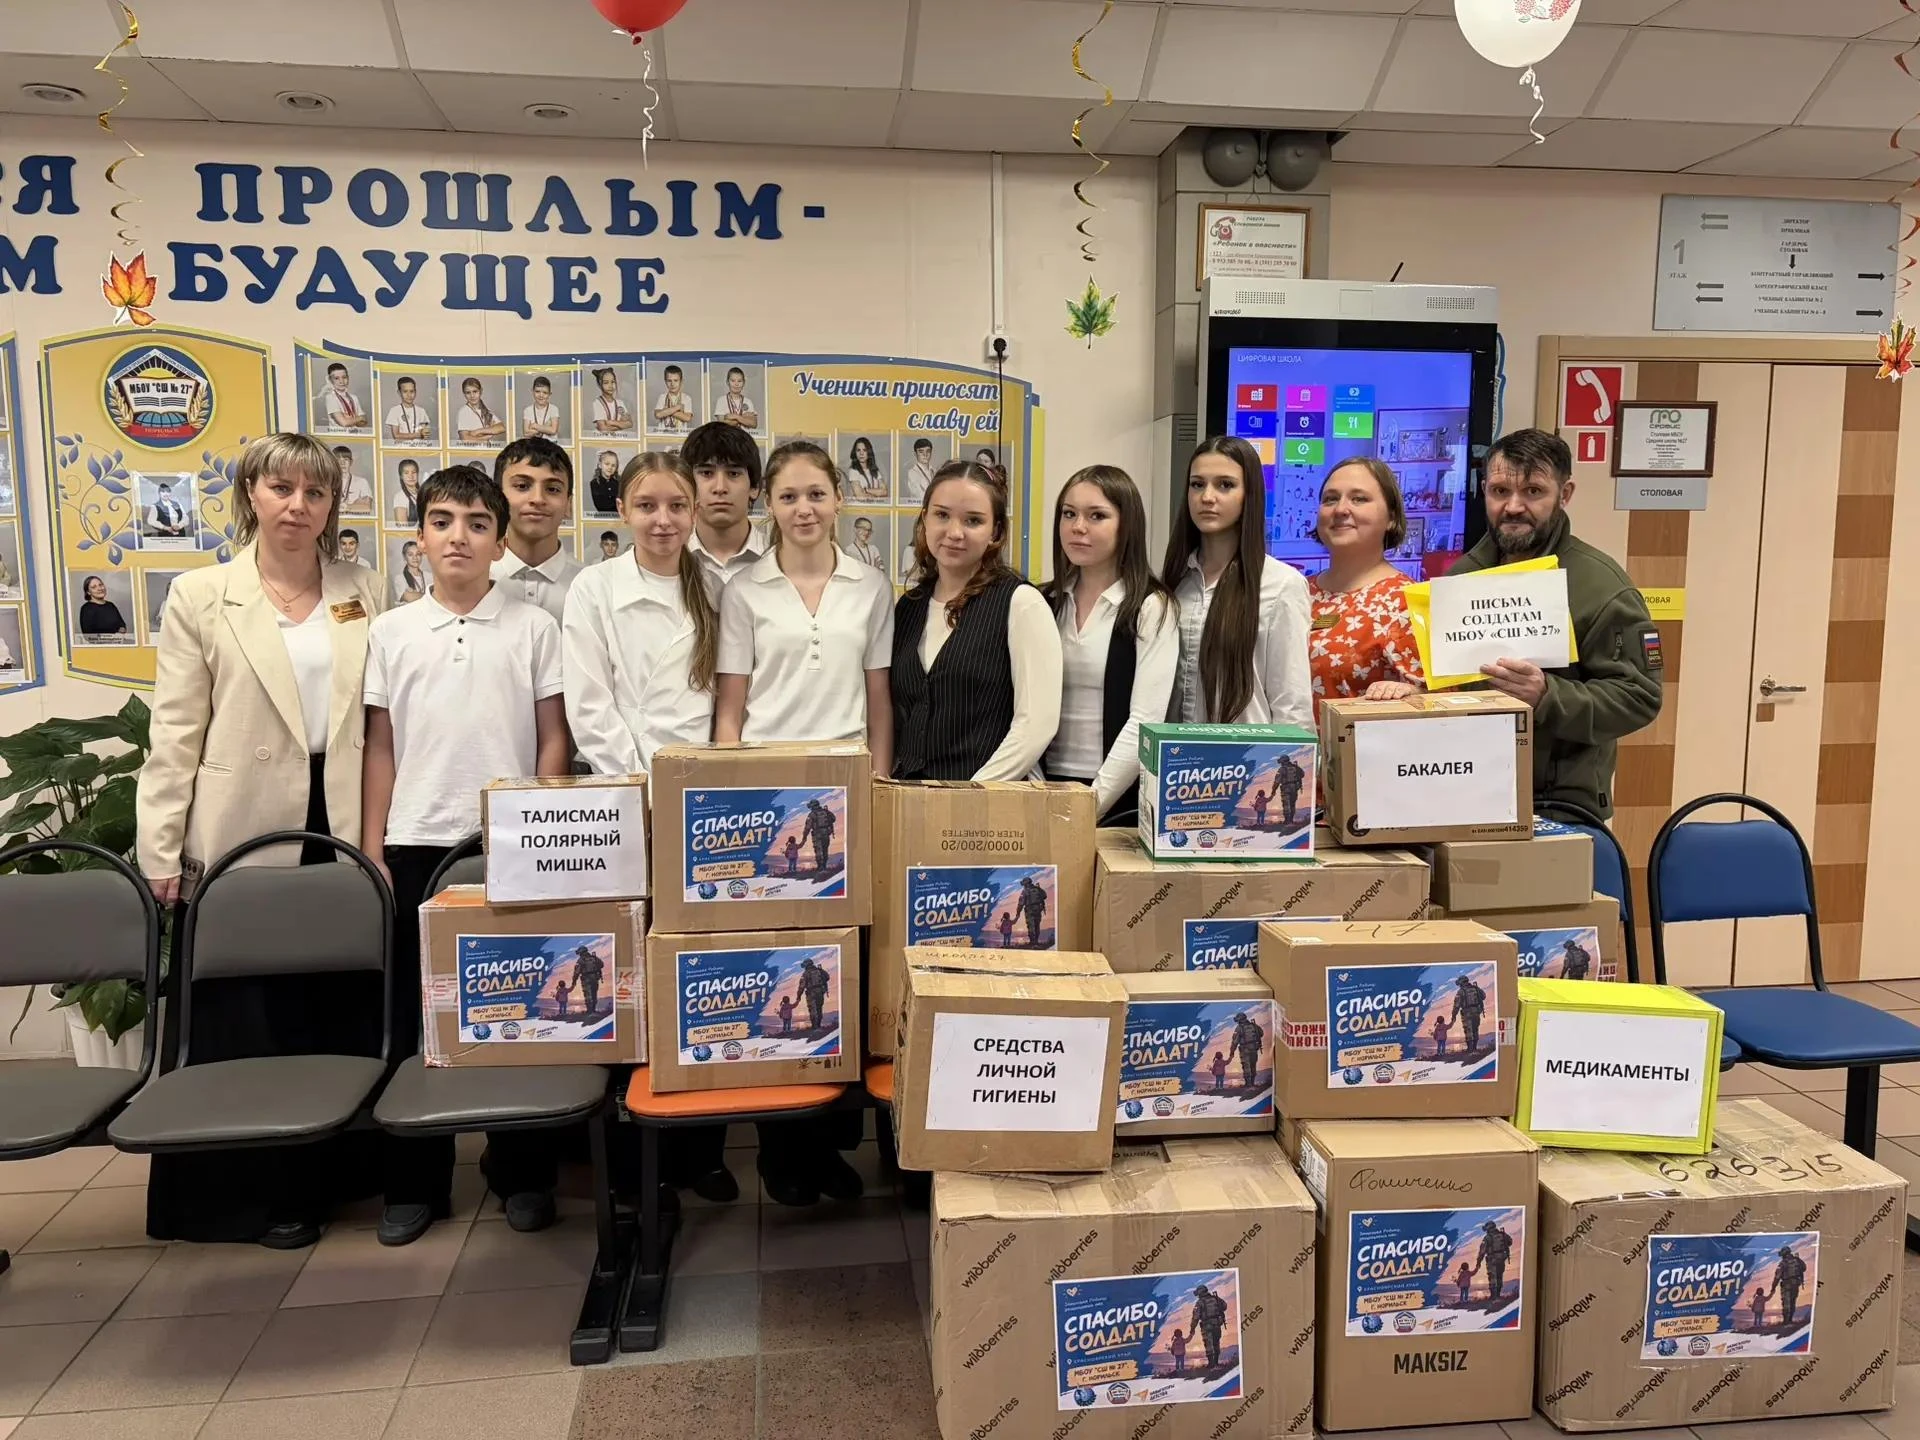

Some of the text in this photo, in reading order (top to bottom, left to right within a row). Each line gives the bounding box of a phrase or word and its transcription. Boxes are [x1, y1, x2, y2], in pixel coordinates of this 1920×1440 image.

[1673, 239, 1686, 264] 1
[167, 241, 669, 320] БУДУЩЕЕ
[1277, 355, 1302, 363] ШКОЛА
[129, 383, 150, 393] МБОУ
[793, 372, 998, 403] Ученики приносят
[908, 408, 998, 435] славу ей
[1640, 489, 1683, 497] СТОЛОВАЯ
[1471, 597, 1532, 610] ПИСЬМА
[1462, 611, 1542, 626] СОЛДАТАМ
[1445, 625, 1561, 643] МБОУ «СШ № 27»
[1166, 764, 1249, 784] СПАСИБО,
[1397, 761, 1473, 777] БАКАЛЕЯ
[1165, 780, 1243, 800] СОЛДАТ!
[521, 808, 619, 823] ТАЛИСМАН
[692, 811, 778, 834] СПАСИБО,
[521, 830, 621, 848] ПОЛЯРНЫЙ
[692, 827, 772, 850] СОЛДАТ!
[941, 829, 1025, 838] FILTER CIGARETTES
[537, 857, 607, 872] МИШКА
[914, 888, 994, 910] СПАСИБО,
[1127, 882, 1174, 929] wildberries
[914, 904, 988, 925] СОЛДАТ!
[1192, 942, 1258, 965] СПАСИБ
[465, 956, 548, 977] СПАСИБО,
[466, 972, 542, 993] СОЛДАТ!
[685, 971, 772, 997] СПАСИБО,
[686, 988, 766, 1013] СОЛДАТ!
[1336, 989, 1426, 1015] СПАСИБО,
[692, 1027, 709, 1035] МБОУ
[1336, 1006, 1419, 1033] СОЛДАТ!
[973, 1038, 1065, 1055] СРЕДСТВА
[1343, 1048, 1360, 1056] МБОУ
[976, 1062, 1056, 1079] ЛИЧНОЙ
[1546, 1059, 1690, 1082] МЕДИКАМЕНТЫ
[972, 1089, 1057, 1104] ГИГИЕНЫ
[1659, 1153, 1843, 1182] 626315
[1849, 1196, 1896, 1252] wildberries
[1357, 1234, 1451, 1261] СПАСИБО,
[962, 1231, 1017, 1289] wildberries
[1357, 1252, 1444, 1279] СОЛДАТ!
[1656, 1259, 1748, 1286] СПАСИБО,
[1363, 1295, 1381, 1304] МБОУ
[1655, 1278, 1740, 1304] СОЛДАТ!
[1845, 1273, 1894, 1329] wildberries
[1376, 1300, 1407, 1309] НОРИЛЬСК
[1064, 1301, 1162, 1333] СПАСИБО,
[963, 1315, 1018, 1369] wildberries
[1065, 1320, 1155, 1351] СОЛДАТ!
[1073, 1367, 1092, 1376] МБОУ
[1393, 1350, 1469, 1375] MAKSIZ
[1088, 1371, 1120, 1381] НОРИЛЬСК
[1765, 1356, 1820, 1409] wildberries
[1839, 1349, 1890, 1403] wildberries
[1616, 1368, 1671, 1418] wildberries
[1210, 1386, 1265, 1440] wildberries
